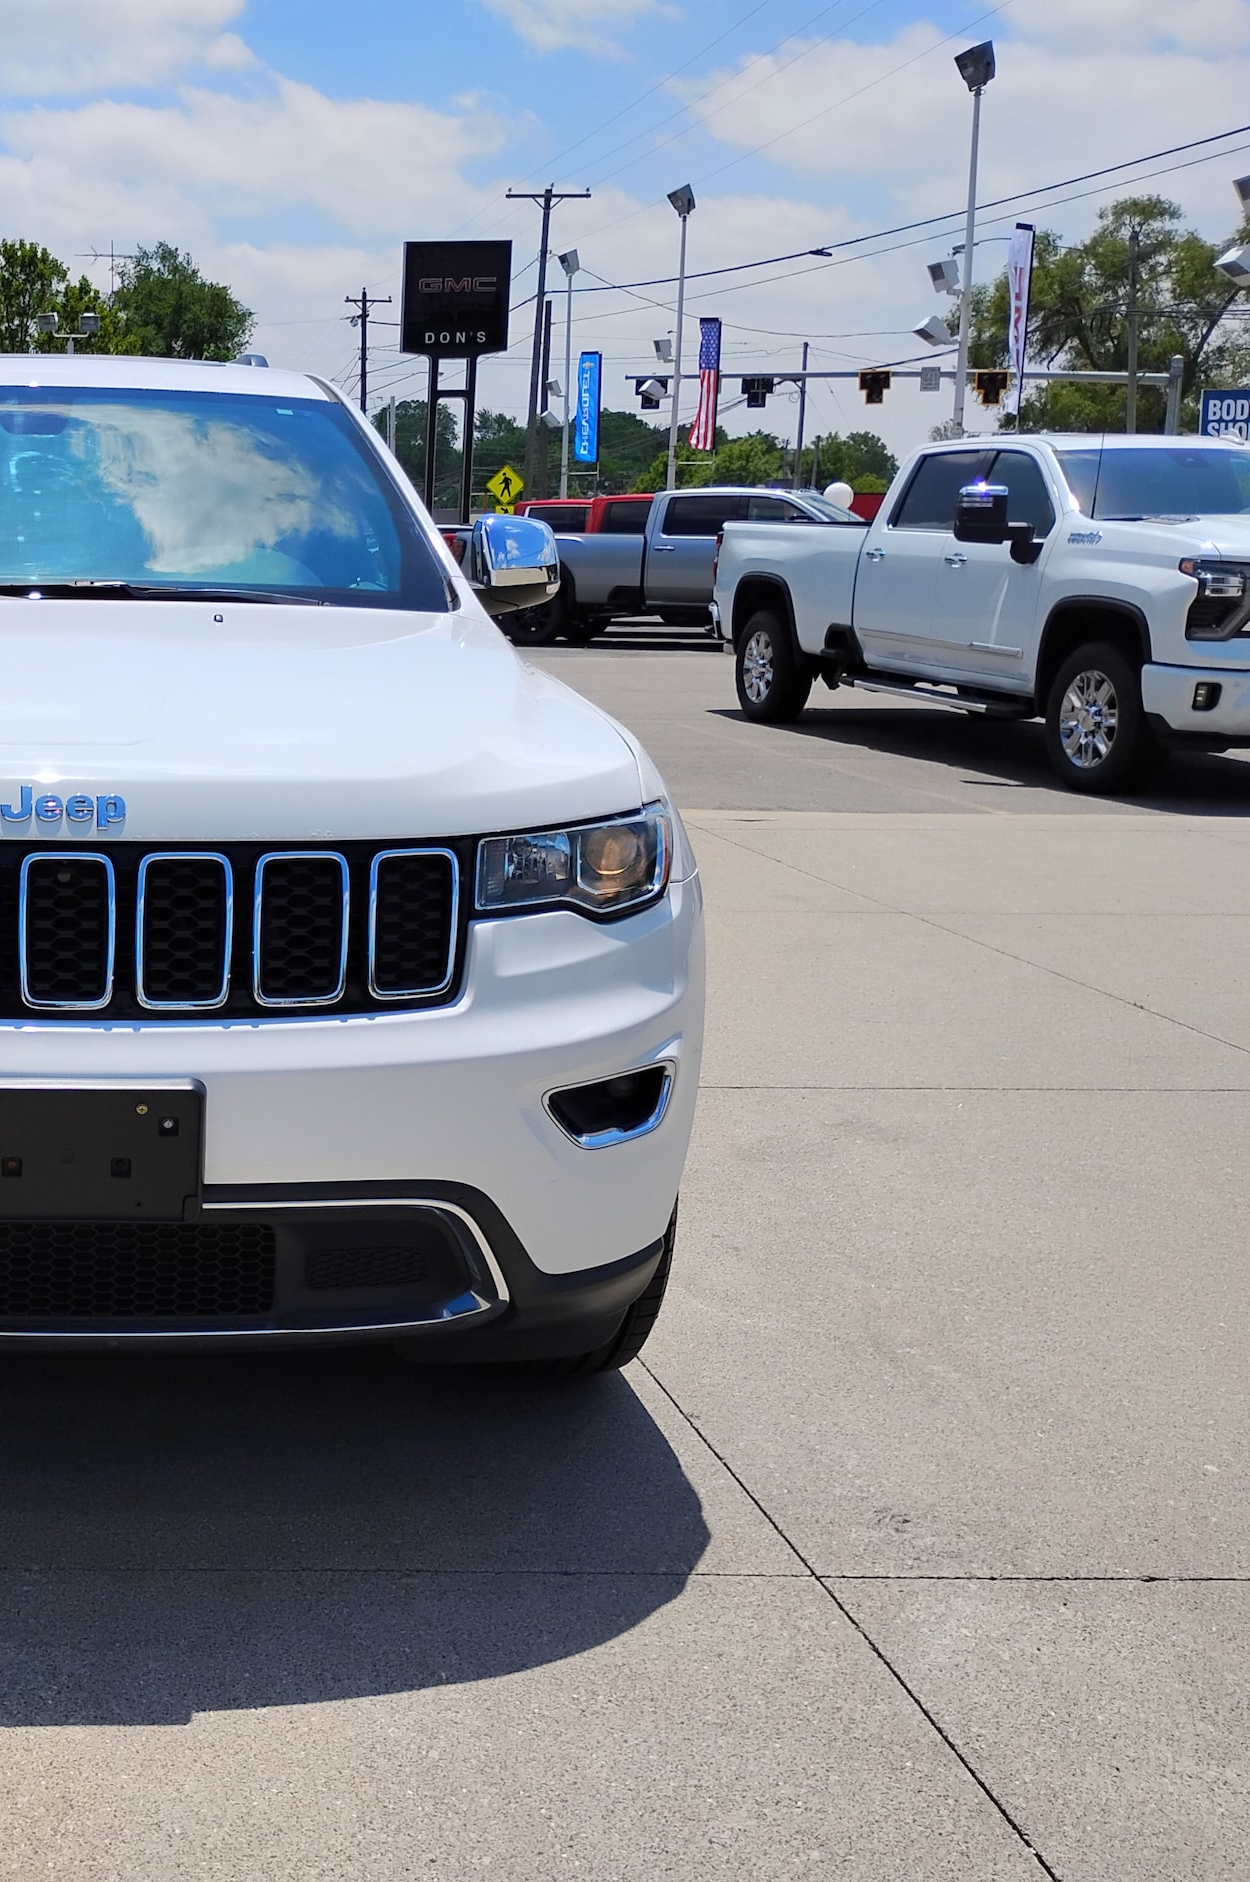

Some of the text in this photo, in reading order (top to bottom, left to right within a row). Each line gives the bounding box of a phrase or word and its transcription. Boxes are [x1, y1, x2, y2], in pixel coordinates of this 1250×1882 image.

[418, 277, 497, 294] GMC
[424, 331, 487, 344] DON'S
[1207, 399, 1250, 421] BOD
[1206, 422, 1250, 441] SHO
[0, 784, 127, 831] Jeep
